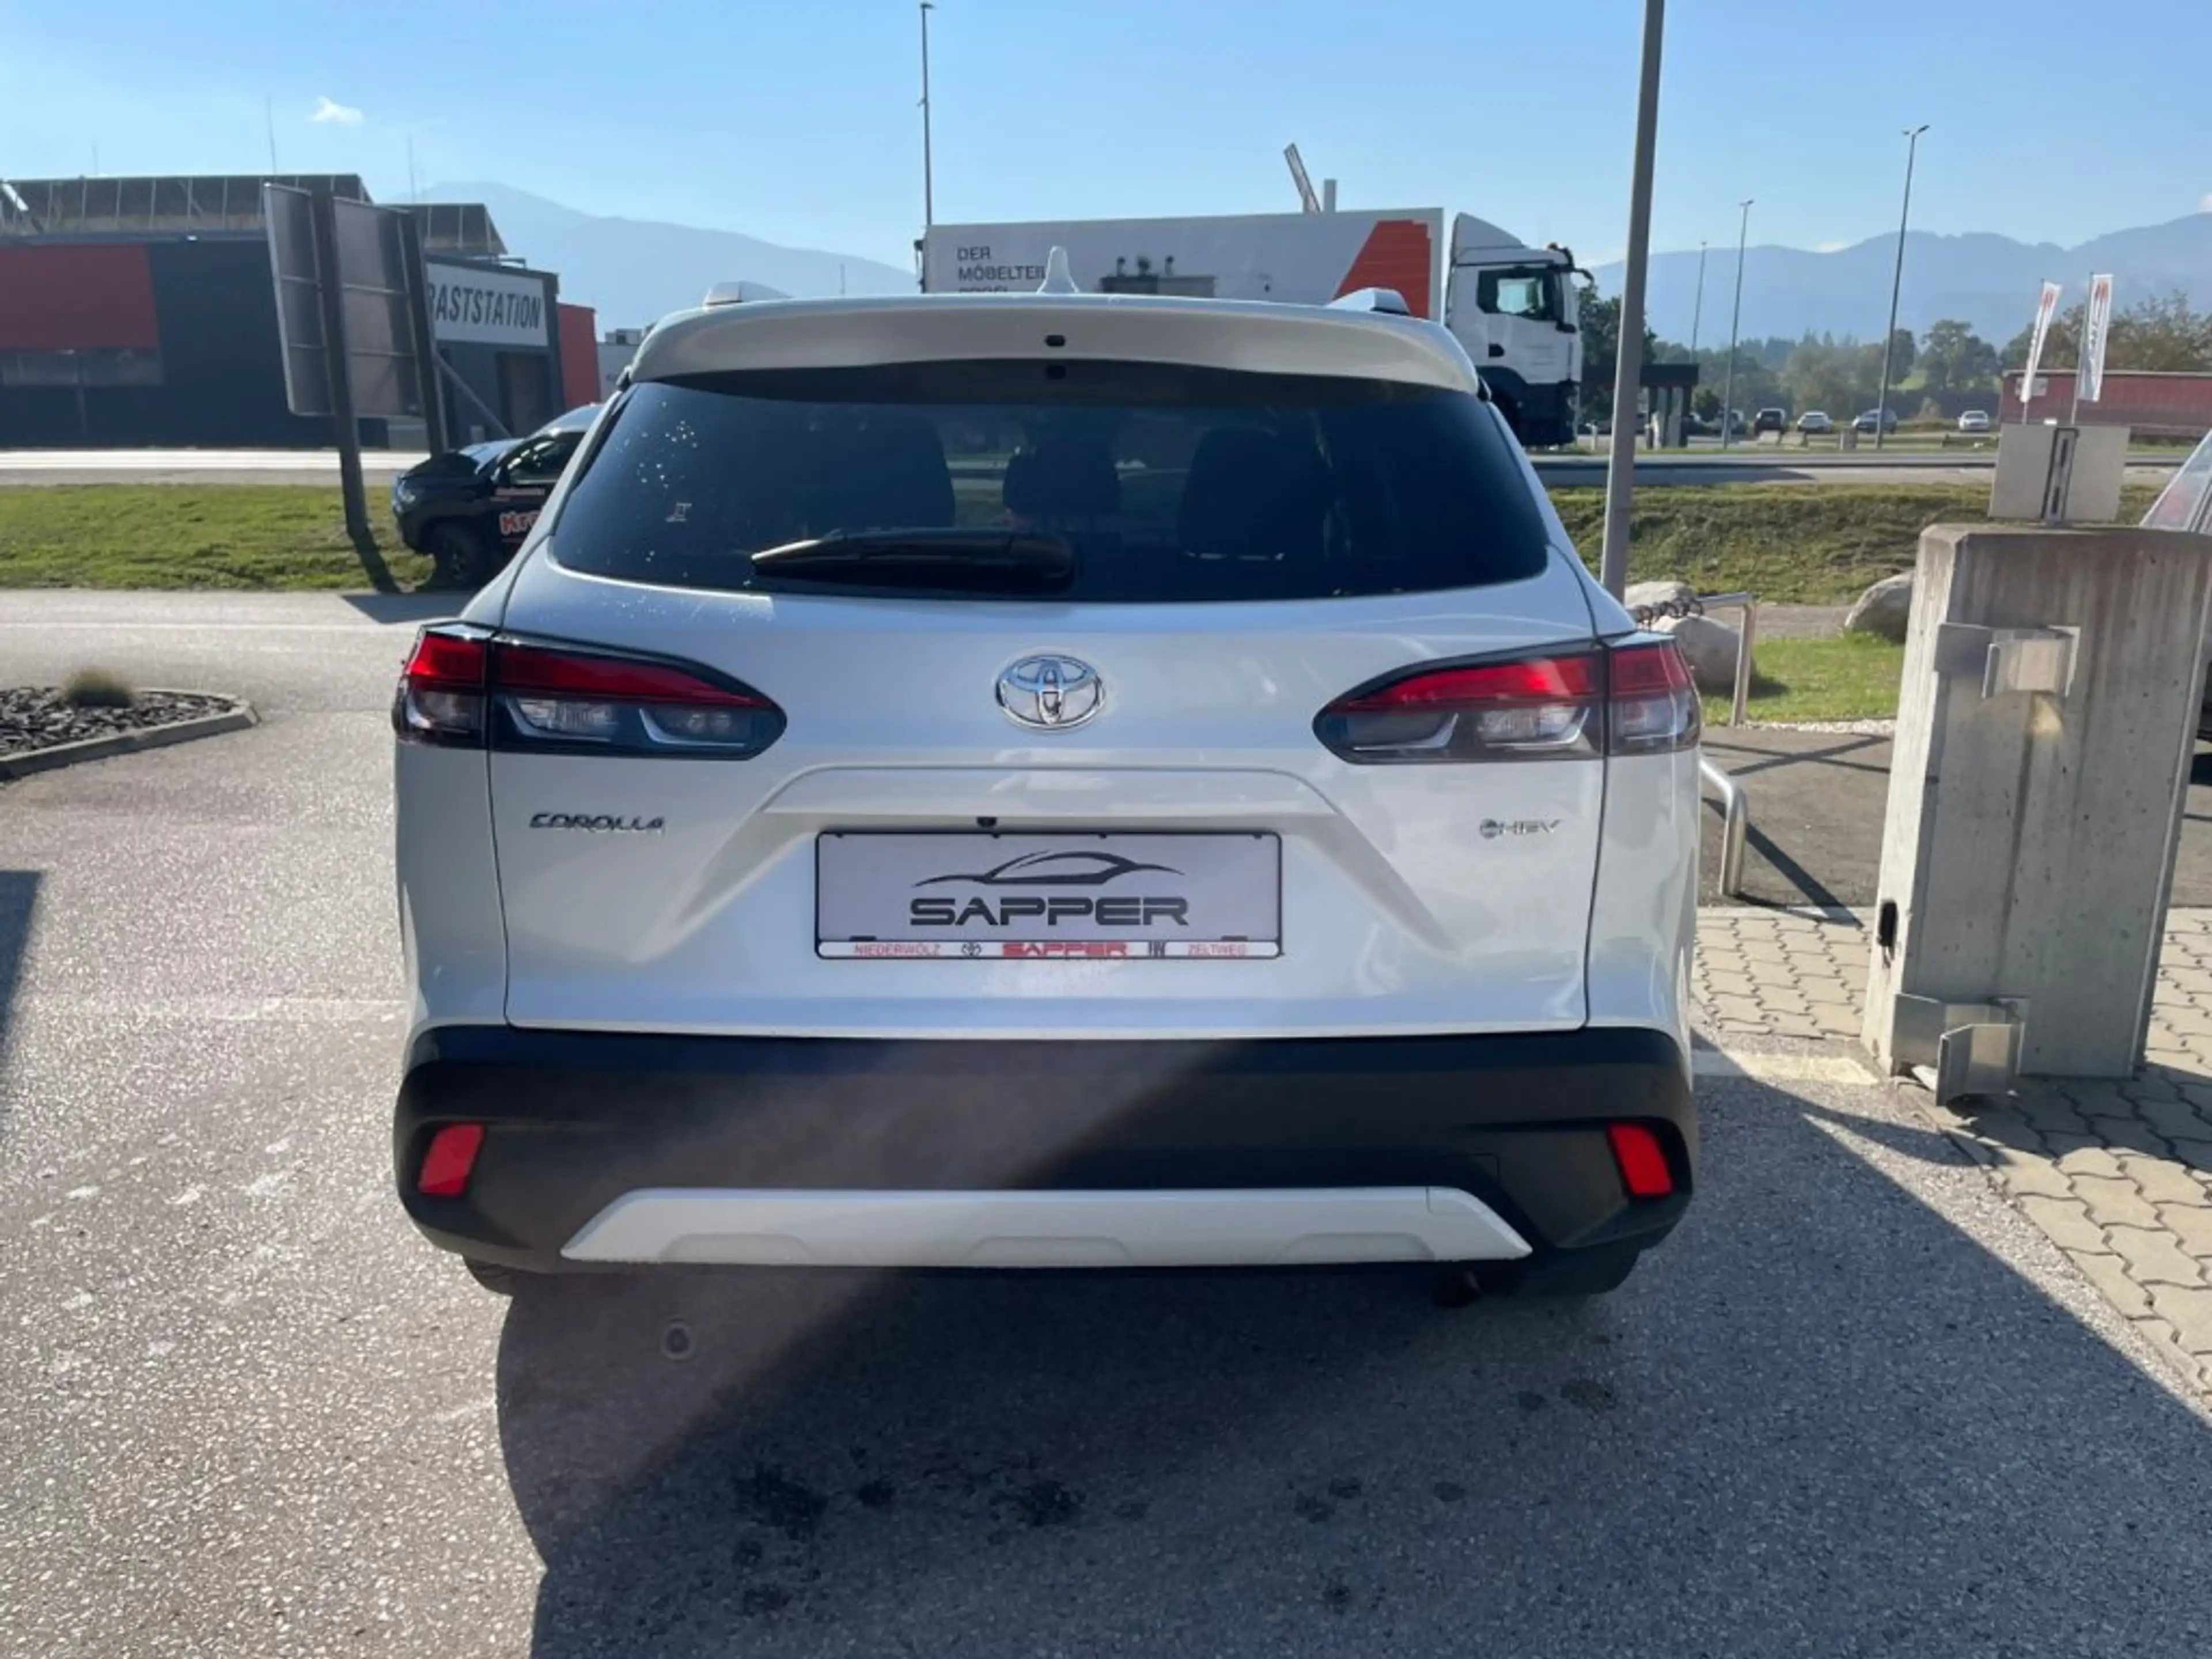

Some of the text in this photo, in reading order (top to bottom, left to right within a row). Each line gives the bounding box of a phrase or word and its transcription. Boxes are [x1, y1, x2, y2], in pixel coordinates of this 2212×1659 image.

[957, 246, 990, 260] DER
[529, 812, 665, 831] COROLLA
[910, 897, 1189, 926] SAPPER
[1002, 941, 1127, 958] SAPPER
